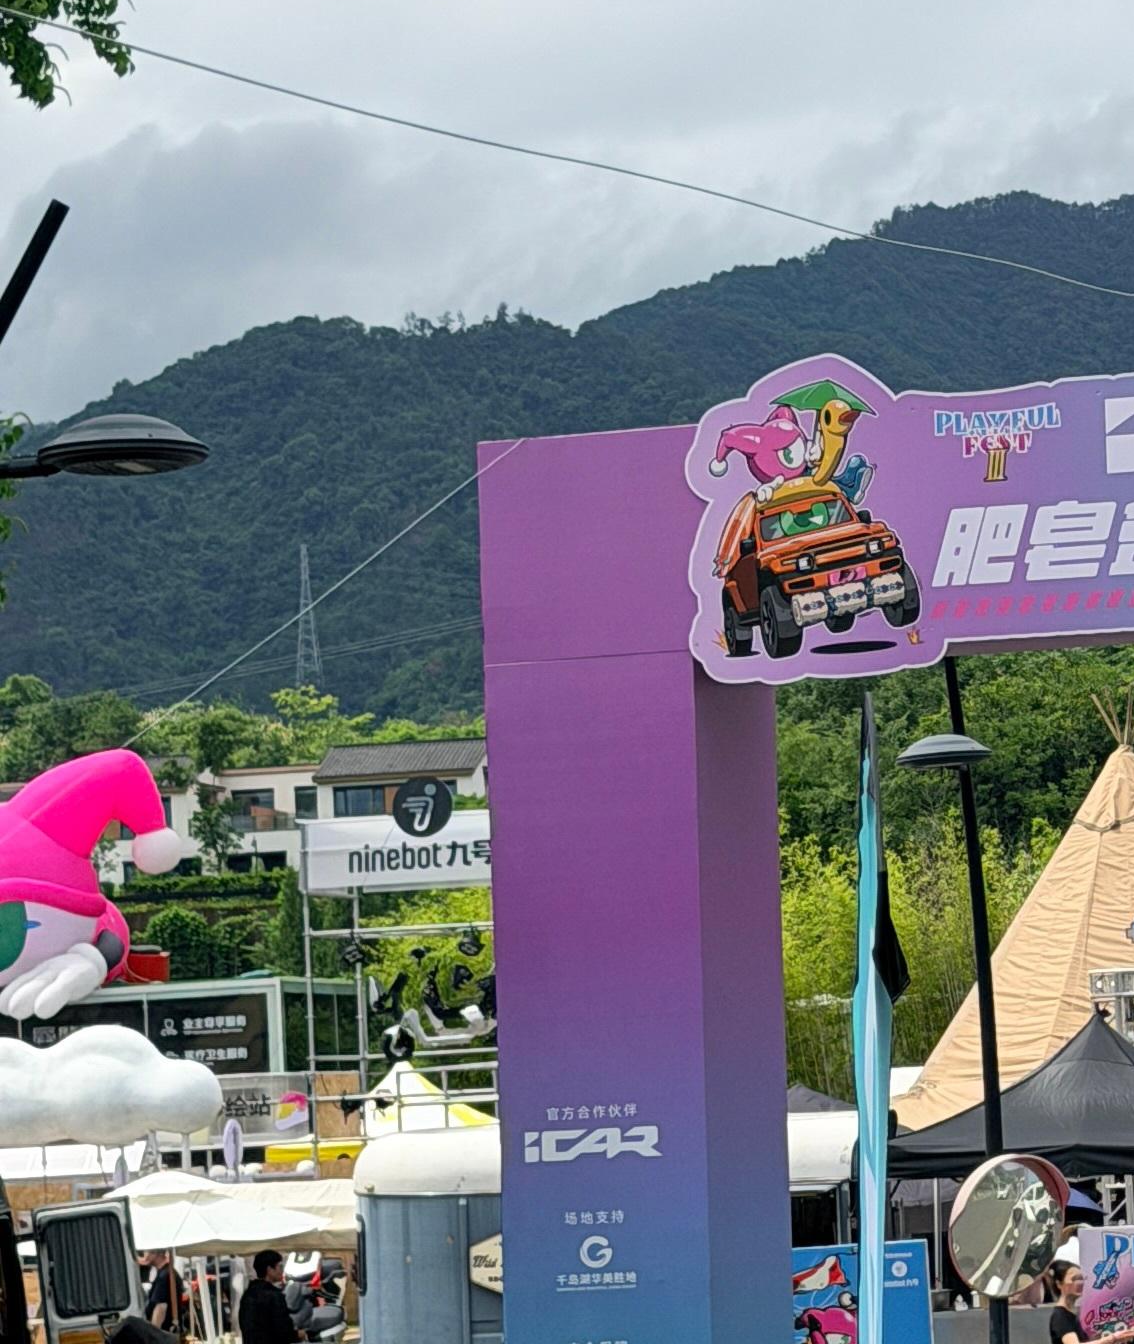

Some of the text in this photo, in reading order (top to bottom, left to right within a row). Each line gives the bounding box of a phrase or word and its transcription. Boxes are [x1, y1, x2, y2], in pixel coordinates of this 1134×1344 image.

[934, 402, 1061, 436] PLAYFUL
[962, 431, 1032, 458] FEST
[349, 842, 442, 873] ninebot
[546, 1103, 638, 1121] 官方合作伙伴
[564, 1210, 624, 1225] 场地支持
[556, 1272, 637, 1286] 千岛湖华美胜地
